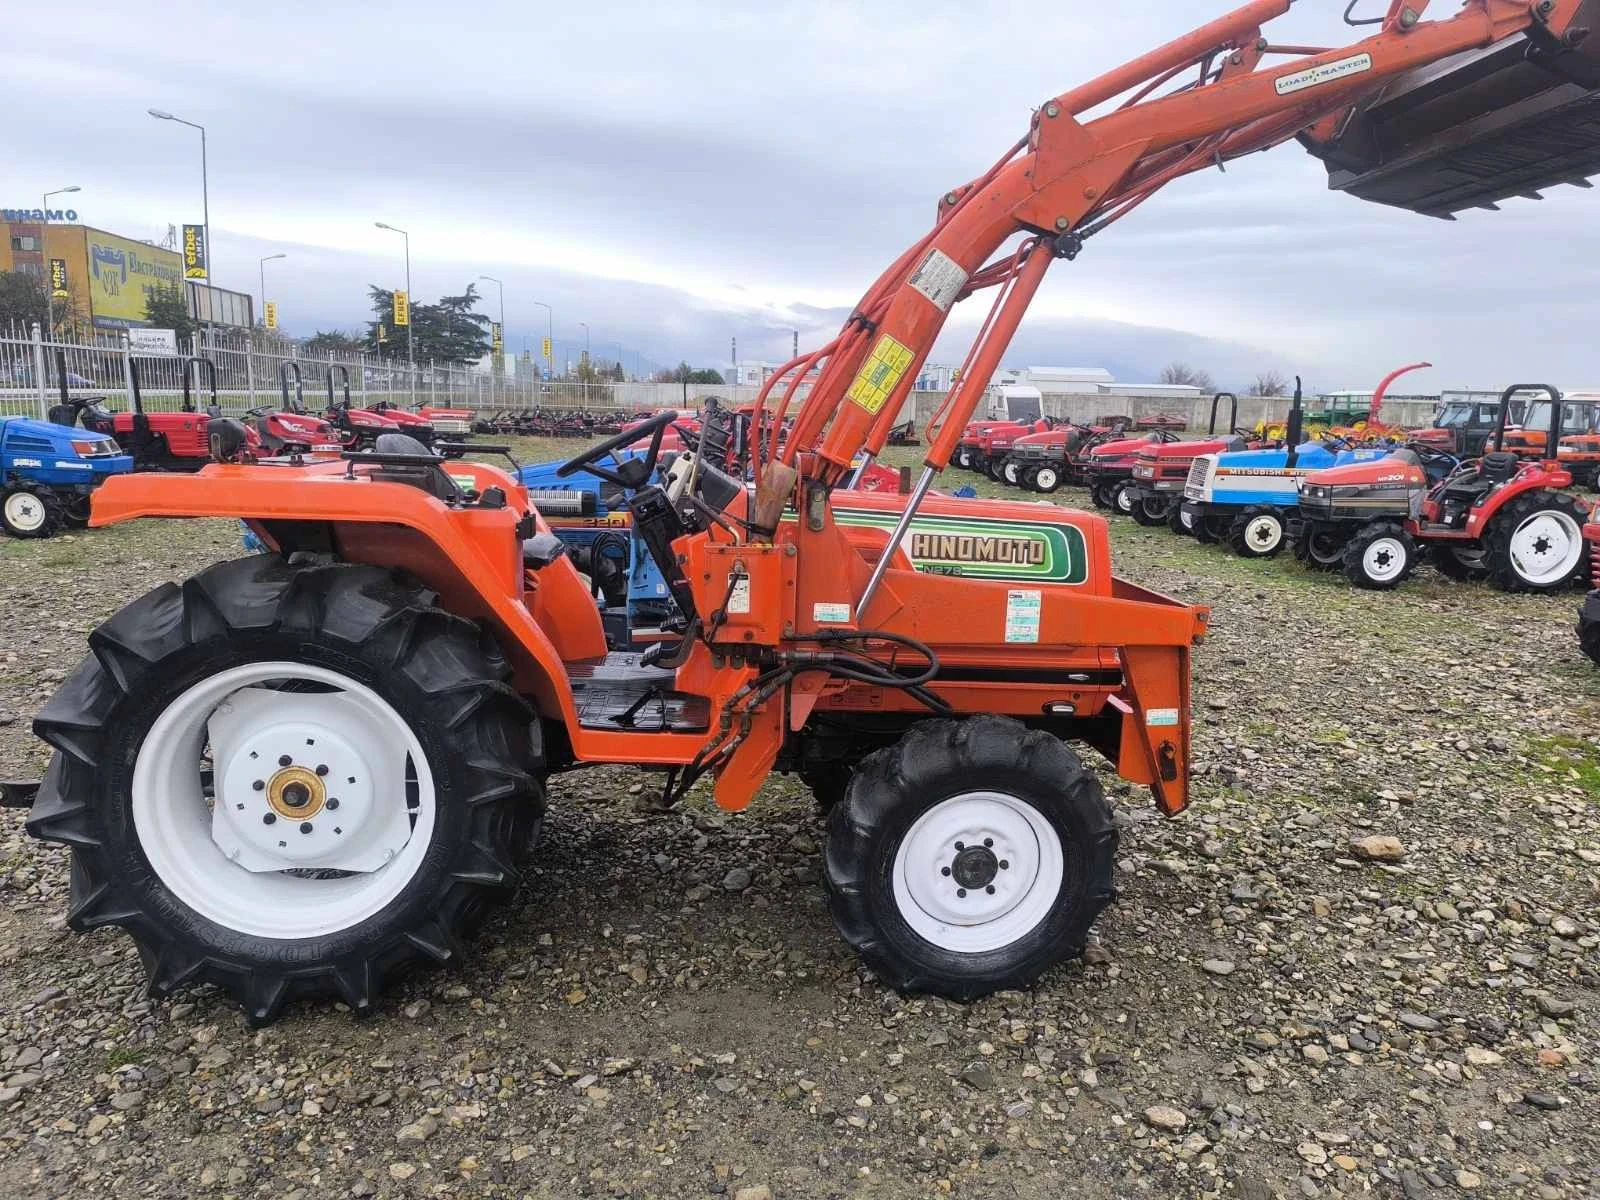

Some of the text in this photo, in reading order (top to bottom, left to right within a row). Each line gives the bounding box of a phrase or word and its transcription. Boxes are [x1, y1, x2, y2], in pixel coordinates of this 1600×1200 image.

[1277, 57, 1369, 89] LOAD MASTER
[184, 227, 197, 265] efbet
[1229, 468, 1285, 477] MITSUBISHI
[911, 534, 1046, 565] HINOMOTO
[923, 565, 962, 576] N279
